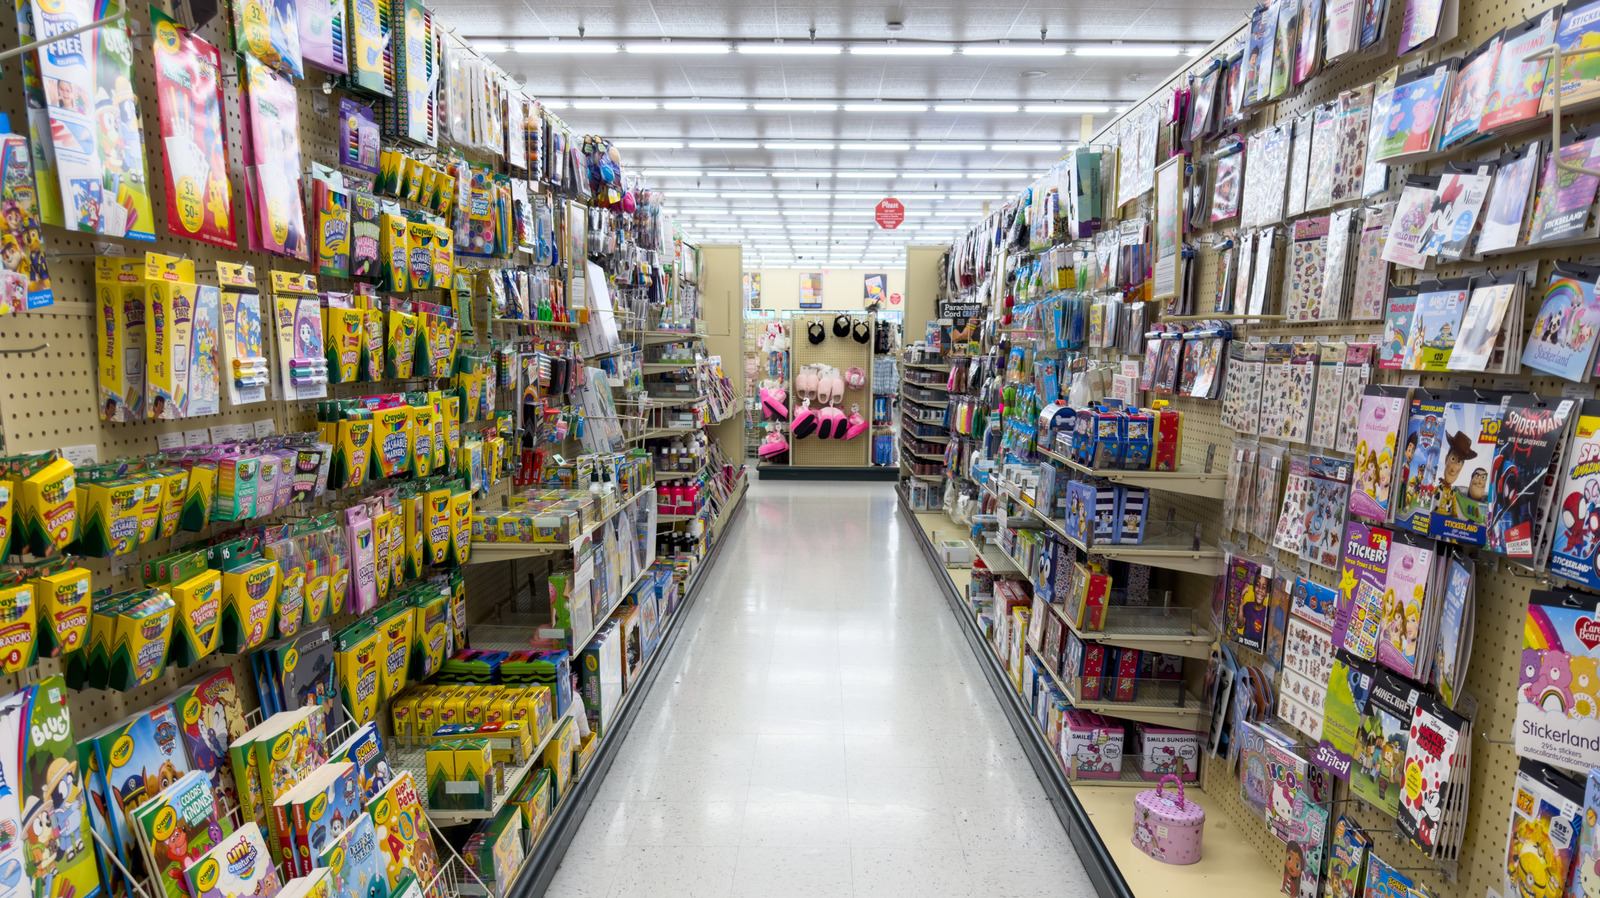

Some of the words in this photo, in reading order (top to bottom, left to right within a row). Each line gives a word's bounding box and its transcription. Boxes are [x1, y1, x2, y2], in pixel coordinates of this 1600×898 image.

[251, 8, 261, 20] 32
[1572, 10, 1600, 27] STICKE
[44, 20, 79, 37] MESS
[49, 37, 82, 56] FREE
[184, 181, 194, 196] 32
[184, 205, 199, 219] 50+
[881, 201, 899, 209] Please
[1544, 210, 1582, 230] STICKERLAND
[412, 226, 433, 236] Crayola
[102, 258, 107, 267] 2
[151, 256, 156, 265] 2
[410, 253, 432, 264] WASHABLE
[412, 262, 430, 272] MARKERS
[276, 275, 283, 283] 16
[1390, 303, 1415, 313] Stickerl
[344, 312, 360, 324] Crayola
[341, 350, 358, 366] MARKERS
[1434, 353, 1443, 361] 120
[1533, 344, 1573, 367] Stickerland
[384, 412, 406, 424] Crayola
[416, 412, 431, 421] Crayola
[1365, 422, 1389, 433] Stickerland
[1420, 421, 1441, 436] PAW
[383, 439, 408, 452] WASHABLE
[1523, 438, 1547, 447] SPIDERVERSE
[352, 450, 366, 459] JUMBO
[385, 448, 406, 460] MARKERS
[92, 471, 99, 479] 24
[1571, 464, 1600, 480] AMAZIN
[114, 490, 134, 498] Crayo
[47, 510, 76, 532] CRAYONS
[110, 521, 138, 533] WASHABLE
[1445, 520, 1478, 532] STICKERLAND
[60, 530, 67, 539] 16
[112, 529, 135, 540] CRAYONS
[430, 526, 449, 537] COLORED
[456, 530, 470, 542] COLORED
[431, 534, 449, 545] PENCILS
[457, 538, 469, 550] PENCILS
[1507, 540, 1529, 548] STICKERLAND
[207, 549, 214, 560] 16
[223, 547, 230, 559] 16
[1348, 541, 1388, 565] STICKERS
[144, 564, 151, 579] 8
[160, 564, 166, 579] 8
[359, 563, 374, 576] COLORED
[1345, 557, 1356, 566] SUPER
[1356, 560, 1368, 569] STARS
[1373, 565, 1386, 574] SMILES
[1552, 556, 1590, 572] STICKERLAND
[173, 566, 179, 580] 8
[249, 569, 270, 584] Crayol
[360, 574, 374, 587] PENCILS
[1394, 571, 1417, 584] Stickerland
[57, 583, 78, 594] Crayo
[194, 582, 214, 596] Crayola
[250, 600, 269, 615] JUMBO
[57, 615, 87, 634] CRAYONS
[249, 609, 268, 625] CRAYONS
[254, 623, 261, 634] 16
[389, 618, 407, 633] Crayola
[1584, 621, 1600, 633] Care
[0, 632, 31, 647] RAYONS
[69, 633, 76, 642] 16
[1579, 628, 1600, 641] Bear
[12, 652, 18, 661] 8
[358, 642, 376, 657] Crayola
[387, 646, 406, 667] COLORED
[387, 659, 405, 677] PENCILS
[356, 671, 376, 694] COLORED
[357, 684, 376, 706] PENCILS
[1373, 686, 1415, 716] MINECRAFT
[185, 702, 200, 720] Crayola
[1326, 716, 1354, 737] Stickerland
[1430, 717, 1442, 731] Disney
[153, 723, 176, 744] PAW
[1419, 723, 1447, 748] MICKEY
[1522, 719, 1600, 752] Stickerland
[113, 738, 130, 757] Crayola
[274, 737, 291, 755] Crayola
[356, 740, 376, 760] SONIC
[1416, 735, 1442, 761] MOUSE
[1541, 742, 1557, 751] 295+
[1558, 745, 1582, 758] stickers
[1524, 746, 1600, 769] autocollants/calcomanía
[297, 766, 312, 782] EPIC
[395, 779, 412, 797] Alph
[180, 786, 202, 809] COLORS
[312, 795, 327, 815] Crayola
[398, 789, 415, 810] Pets
[182, 790, 214, 821] KINDNESS
[376, 800, 390, 818] Crayola
[156, 812, 174, 833] Crayola
[400, 813, 414, 840] B
[1554, 820, 1569, 833] 295+
[227, 835, 251, 863] uni-
[353, 841, 375, 865] FRIENDS
[388, 834, 405, 863] A
[228, 844, 258, 873] creatures!
[331, 850, 343, 870] Crayola
[199, 864, 217, 883] Crayola
[1389, 876, 1408, 893] SONIC
